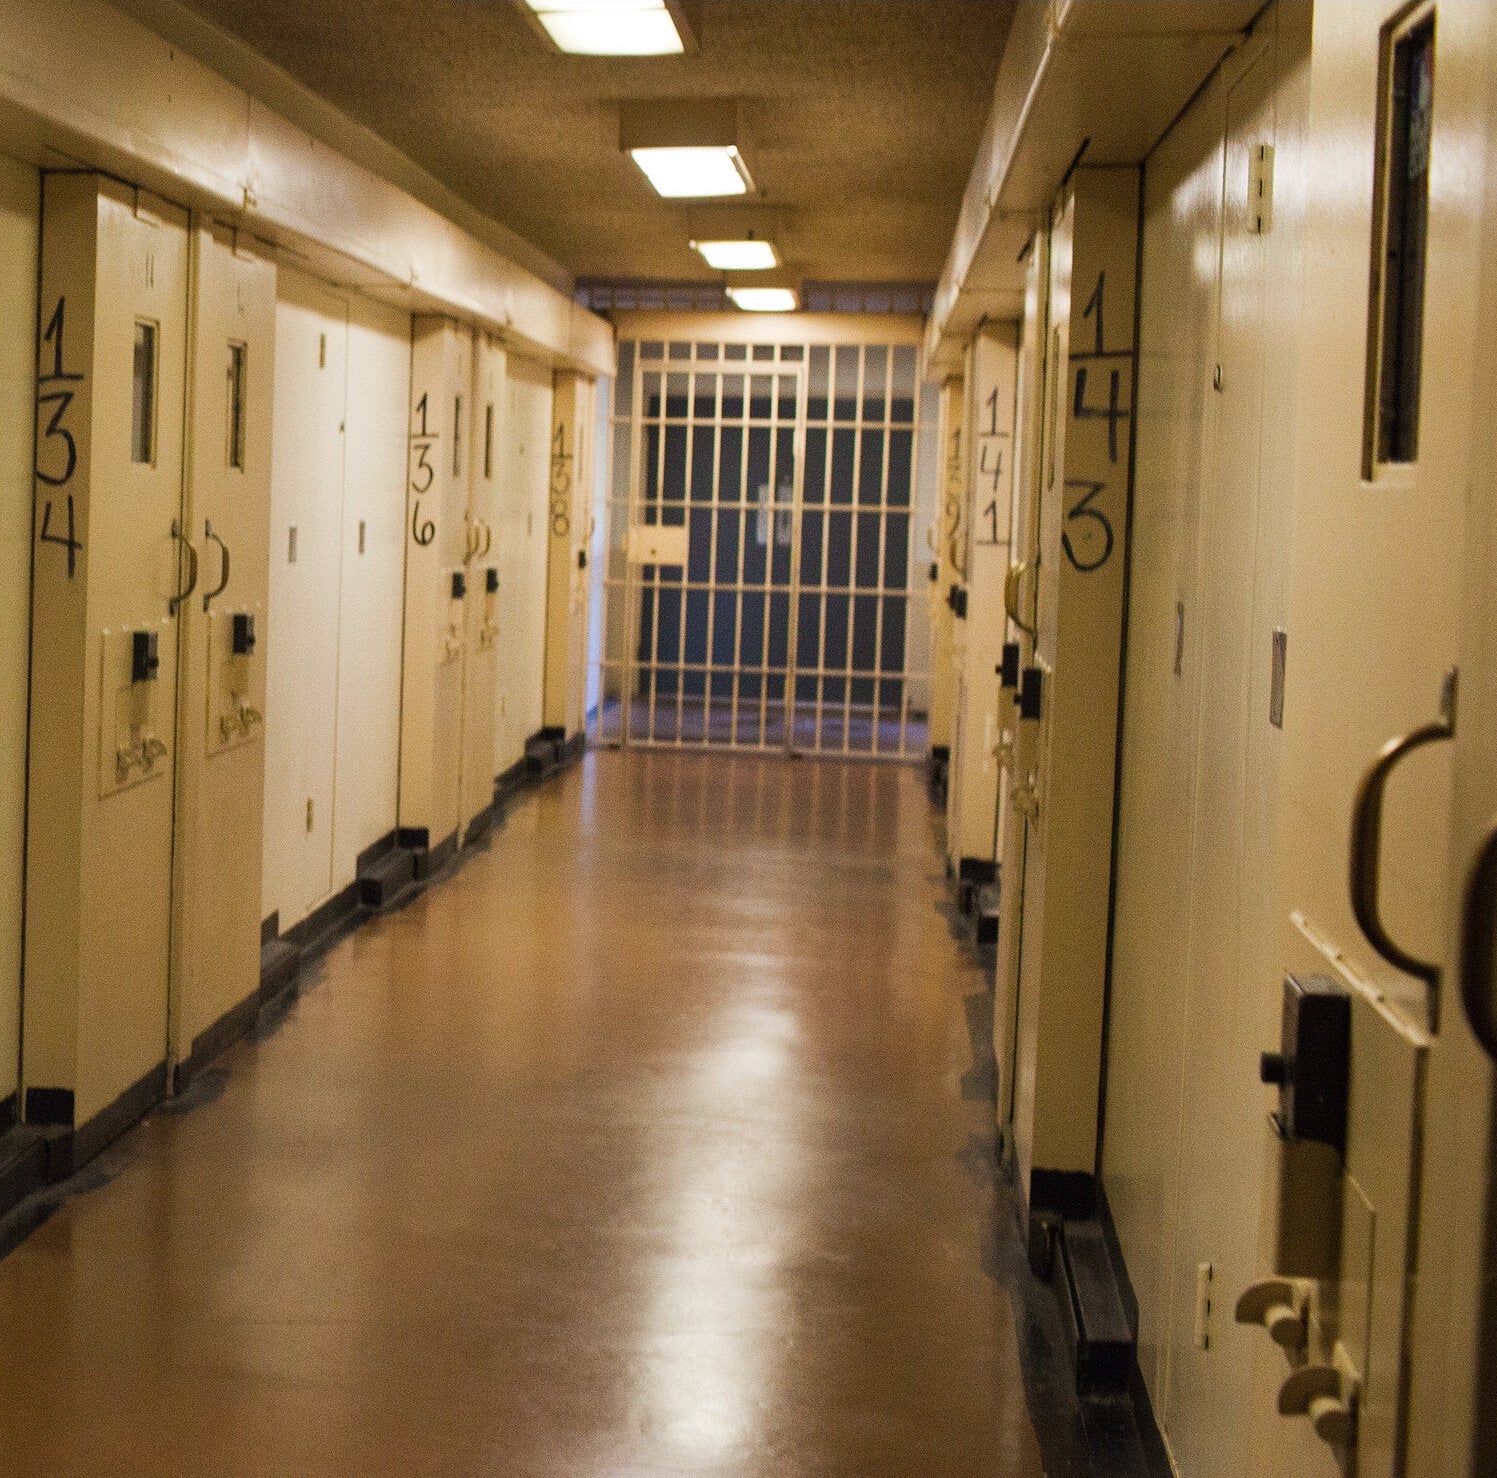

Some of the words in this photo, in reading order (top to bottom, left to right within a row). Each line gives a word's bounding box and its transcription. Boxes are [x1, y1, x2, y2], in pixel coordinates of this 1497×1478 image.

[36, 297, 84, 579] 134
[411, 392, 439, 547] 136
[977, 387, 1010, 545] 141
[1063, 271, 1133, 572] 143
